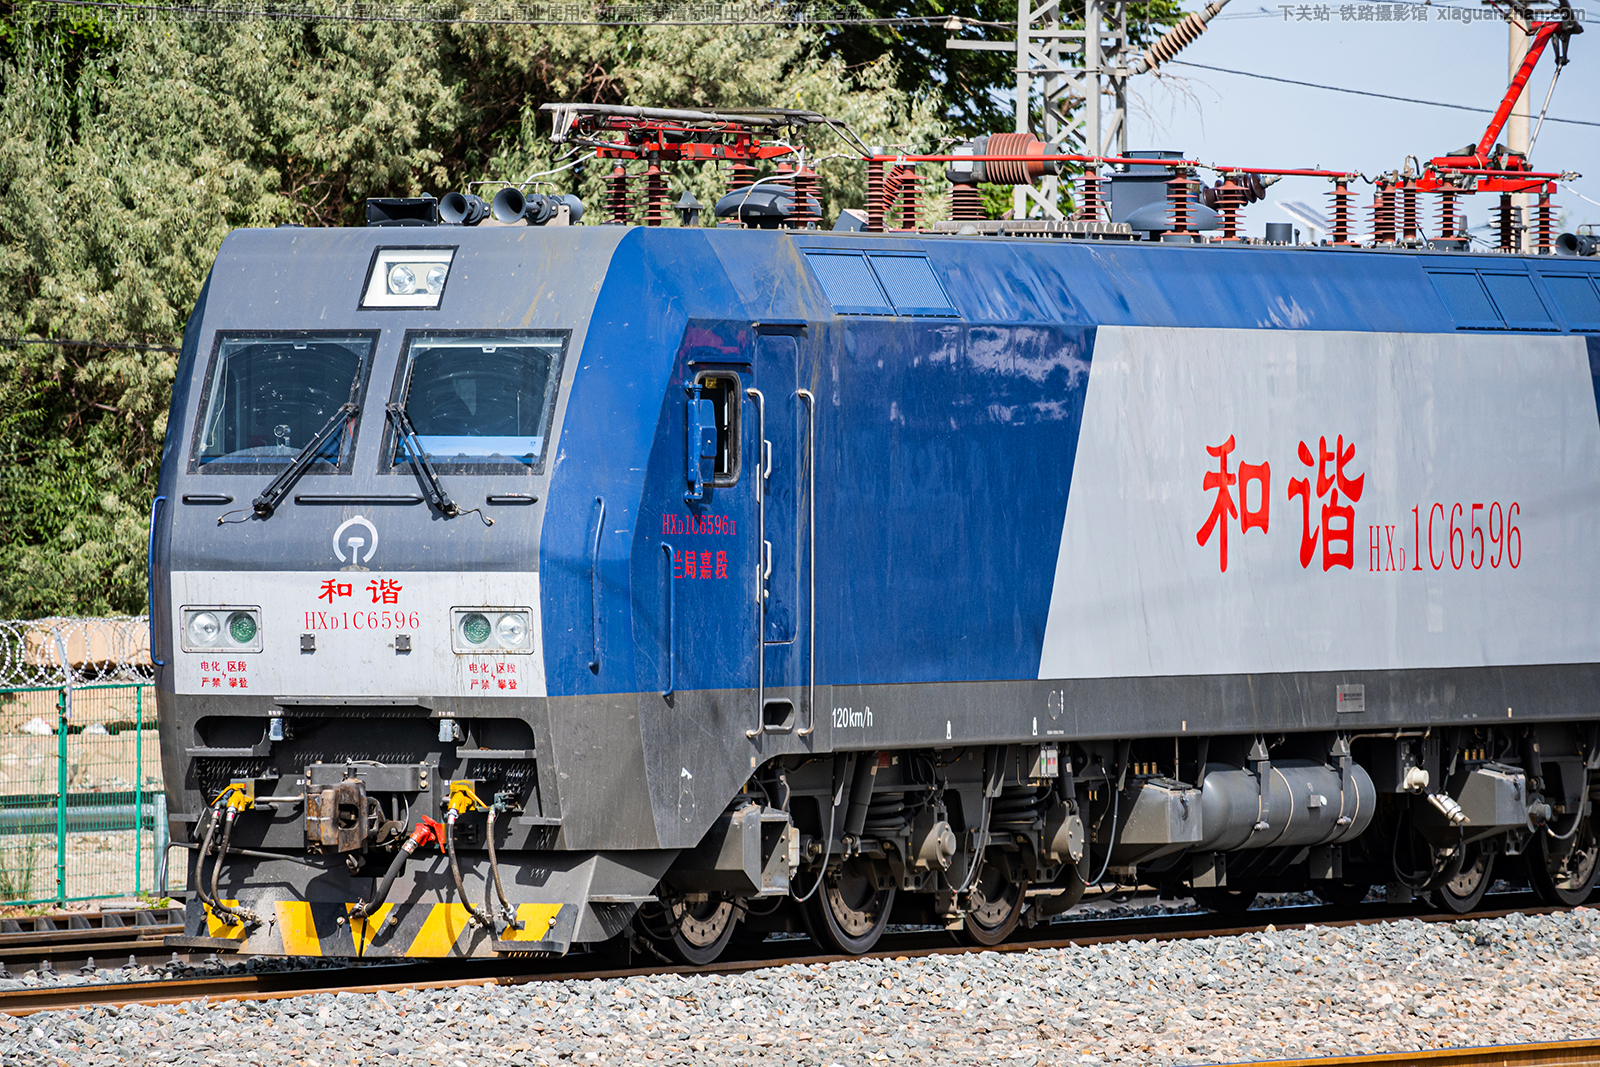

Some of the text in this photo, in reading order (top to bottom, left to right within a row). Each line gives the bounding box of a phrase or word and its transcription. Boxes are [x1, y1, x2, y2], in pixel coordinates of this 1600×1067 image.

[1196, 434, 1366, 574] 和谐
[317, 578, 404, 605] 和谐
[304, 610, 420, 630] HXD1C6596
